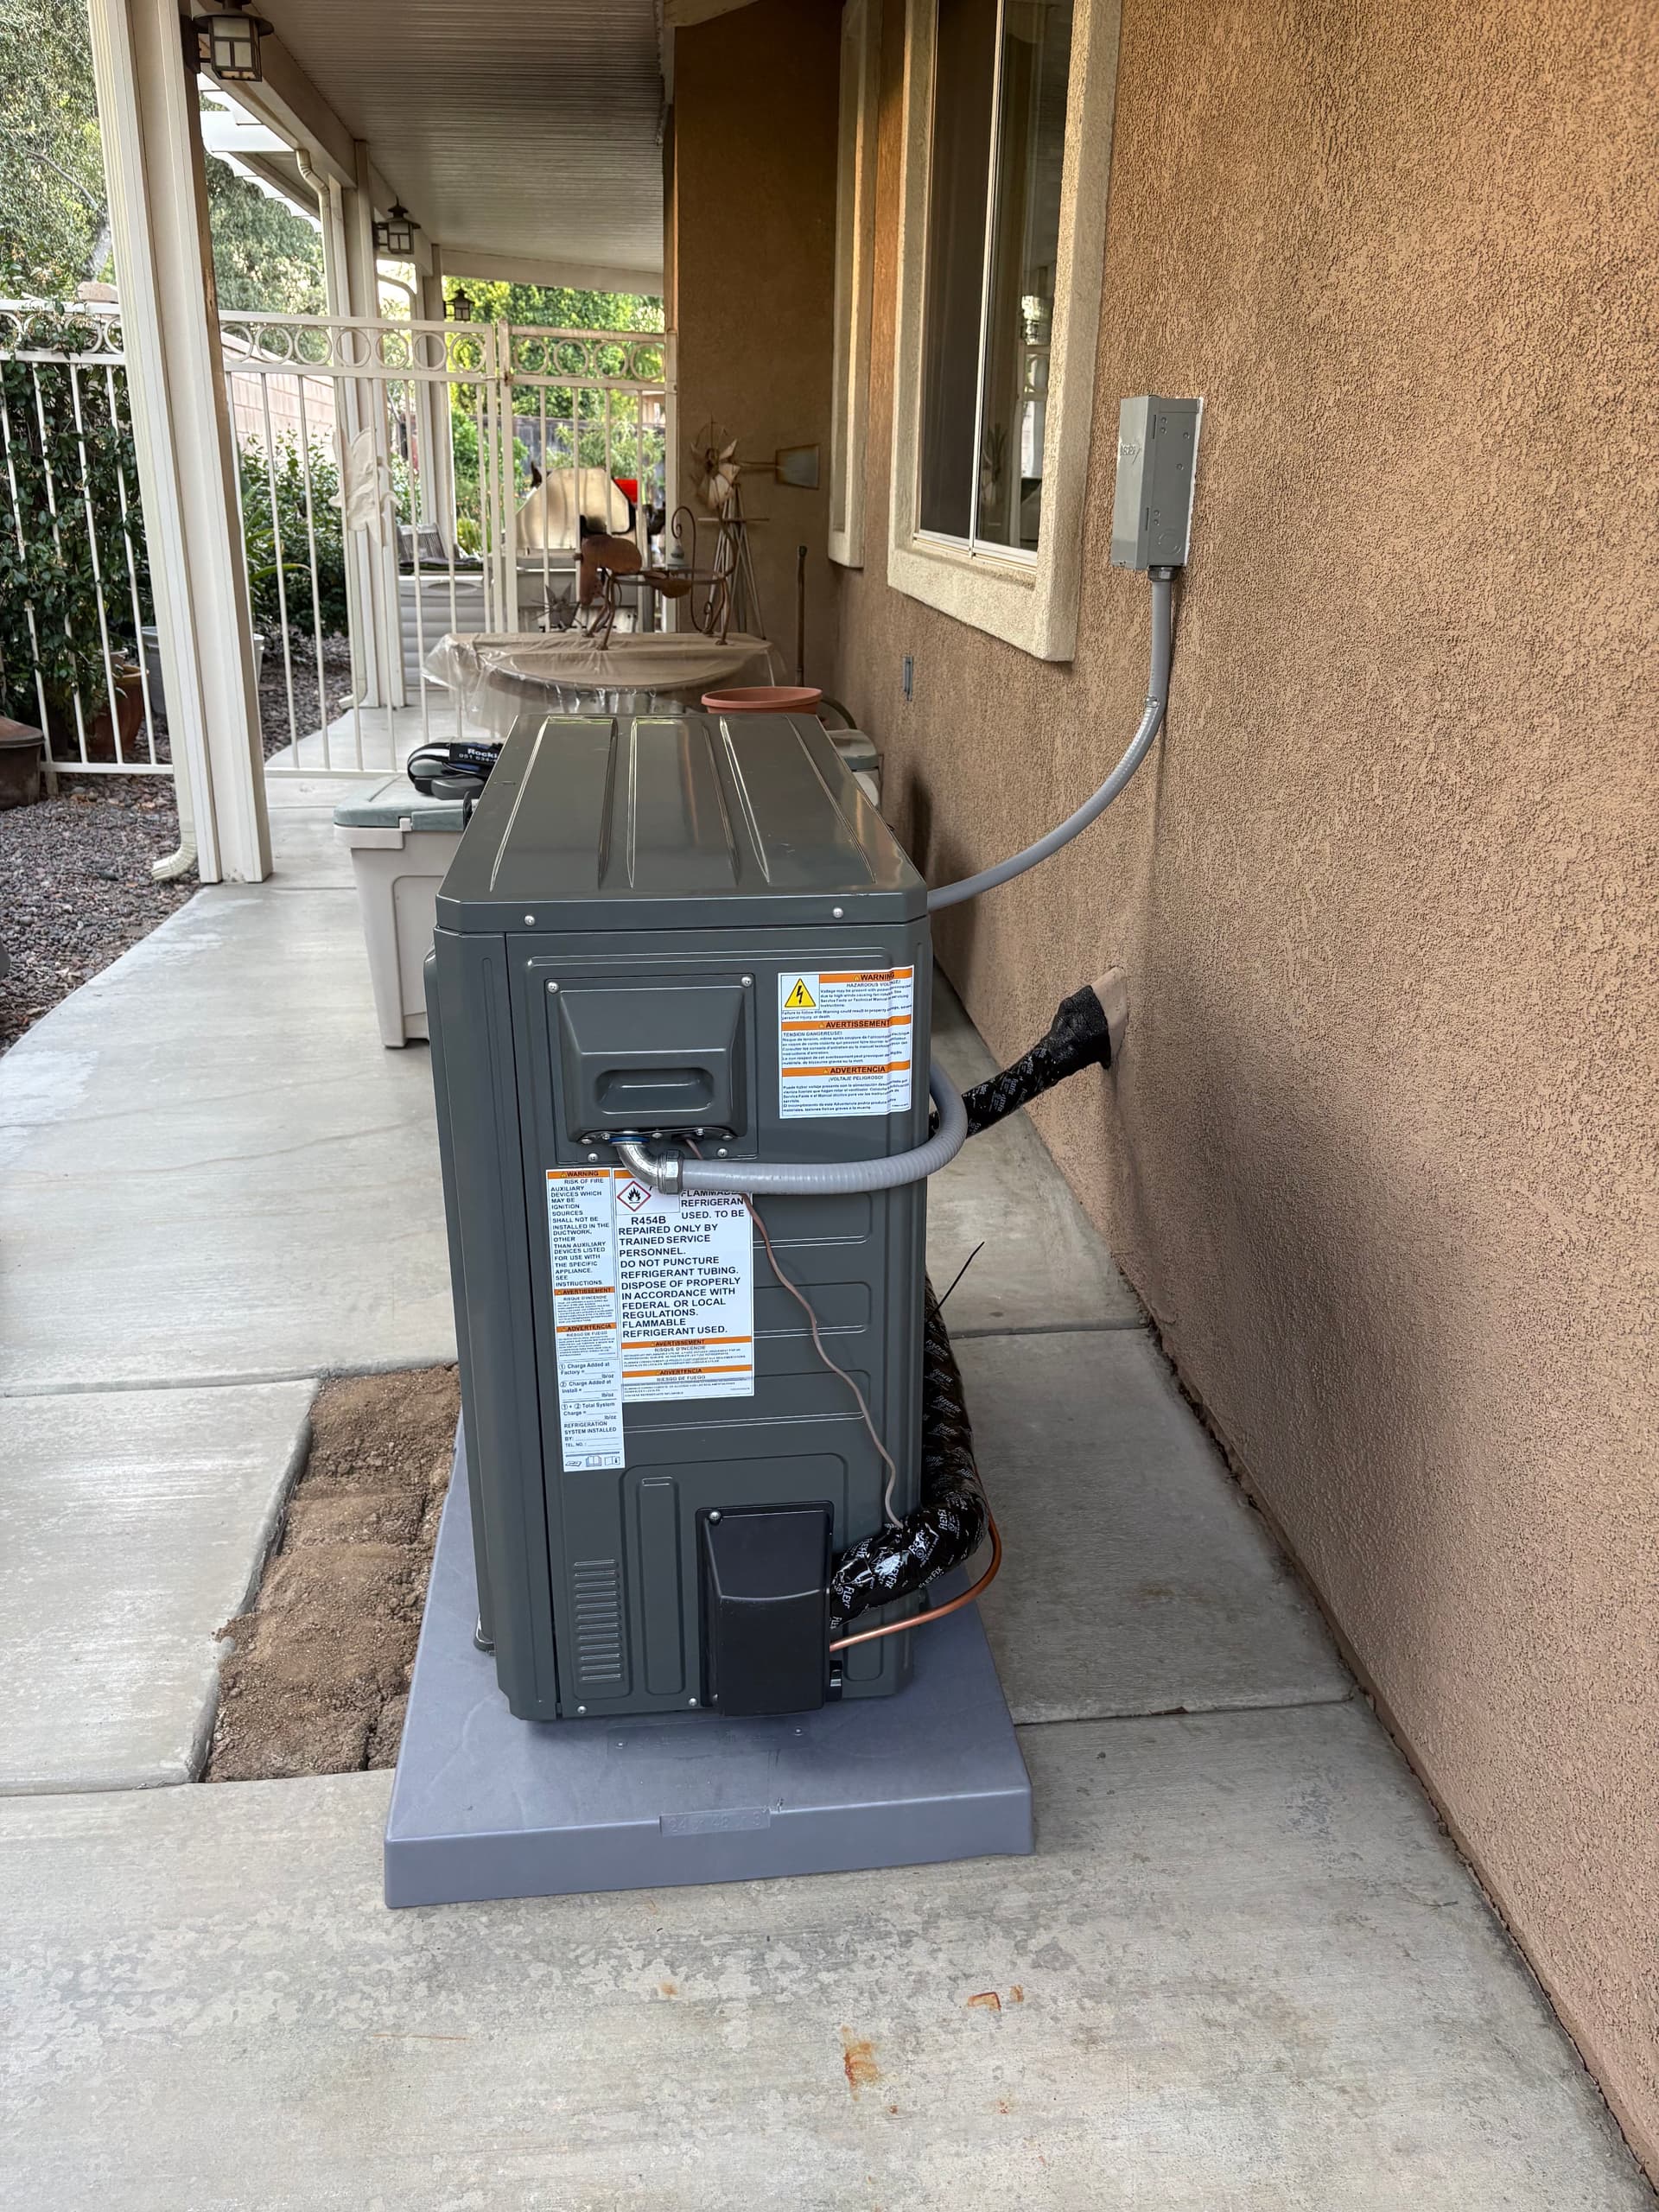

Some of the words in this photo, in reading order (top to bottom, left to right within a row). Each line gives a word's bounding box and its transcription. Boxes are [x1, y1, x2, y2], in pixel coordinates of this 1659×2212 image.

[861, 971, 895, 981] WARNING
[826, 1020, 890, 1028] AVERTISSEMENT
[681, 1198, 745, 1207] REFRIGERAN
[631, 1216, 666, 1225] R454B
[619, 1225, 671, 1236] REPAIRED
[673, 1224, 701, 1233] ONLY
[619, 1236, 664, 1246] TRAINED
[666, 1235, 711, 1244] SERVICE
[620, 1247, 686, 1257] PERSONNEL.
[620, 1260, 636, 1268] DO
[664, 1256, 719, 1266] PUNCTURE
[621, 1268, 695, 1280] REFRIGERANT
[697, 1266, 739, 1275] TUBING.
[621, 1281, 666, 1290] DISPOSE
[670, 1280, 683, 1288] OF
[686, 1277, 741, 1287] PROPERLY
[634, 1289, 707, 1300] ACCORDANCE
[622, 1301, 670, 1310] FEDERAL
[691, 1298, 726, 1307] LOCAL
[622, 1309, 699, 1319] REGULATIONS.
[622, 1318, 686, 1328] FLAMMABLE
[623, 1327, 695, 1338] REFRIGERANT
[697, 1325, 728, 1334] USED.
